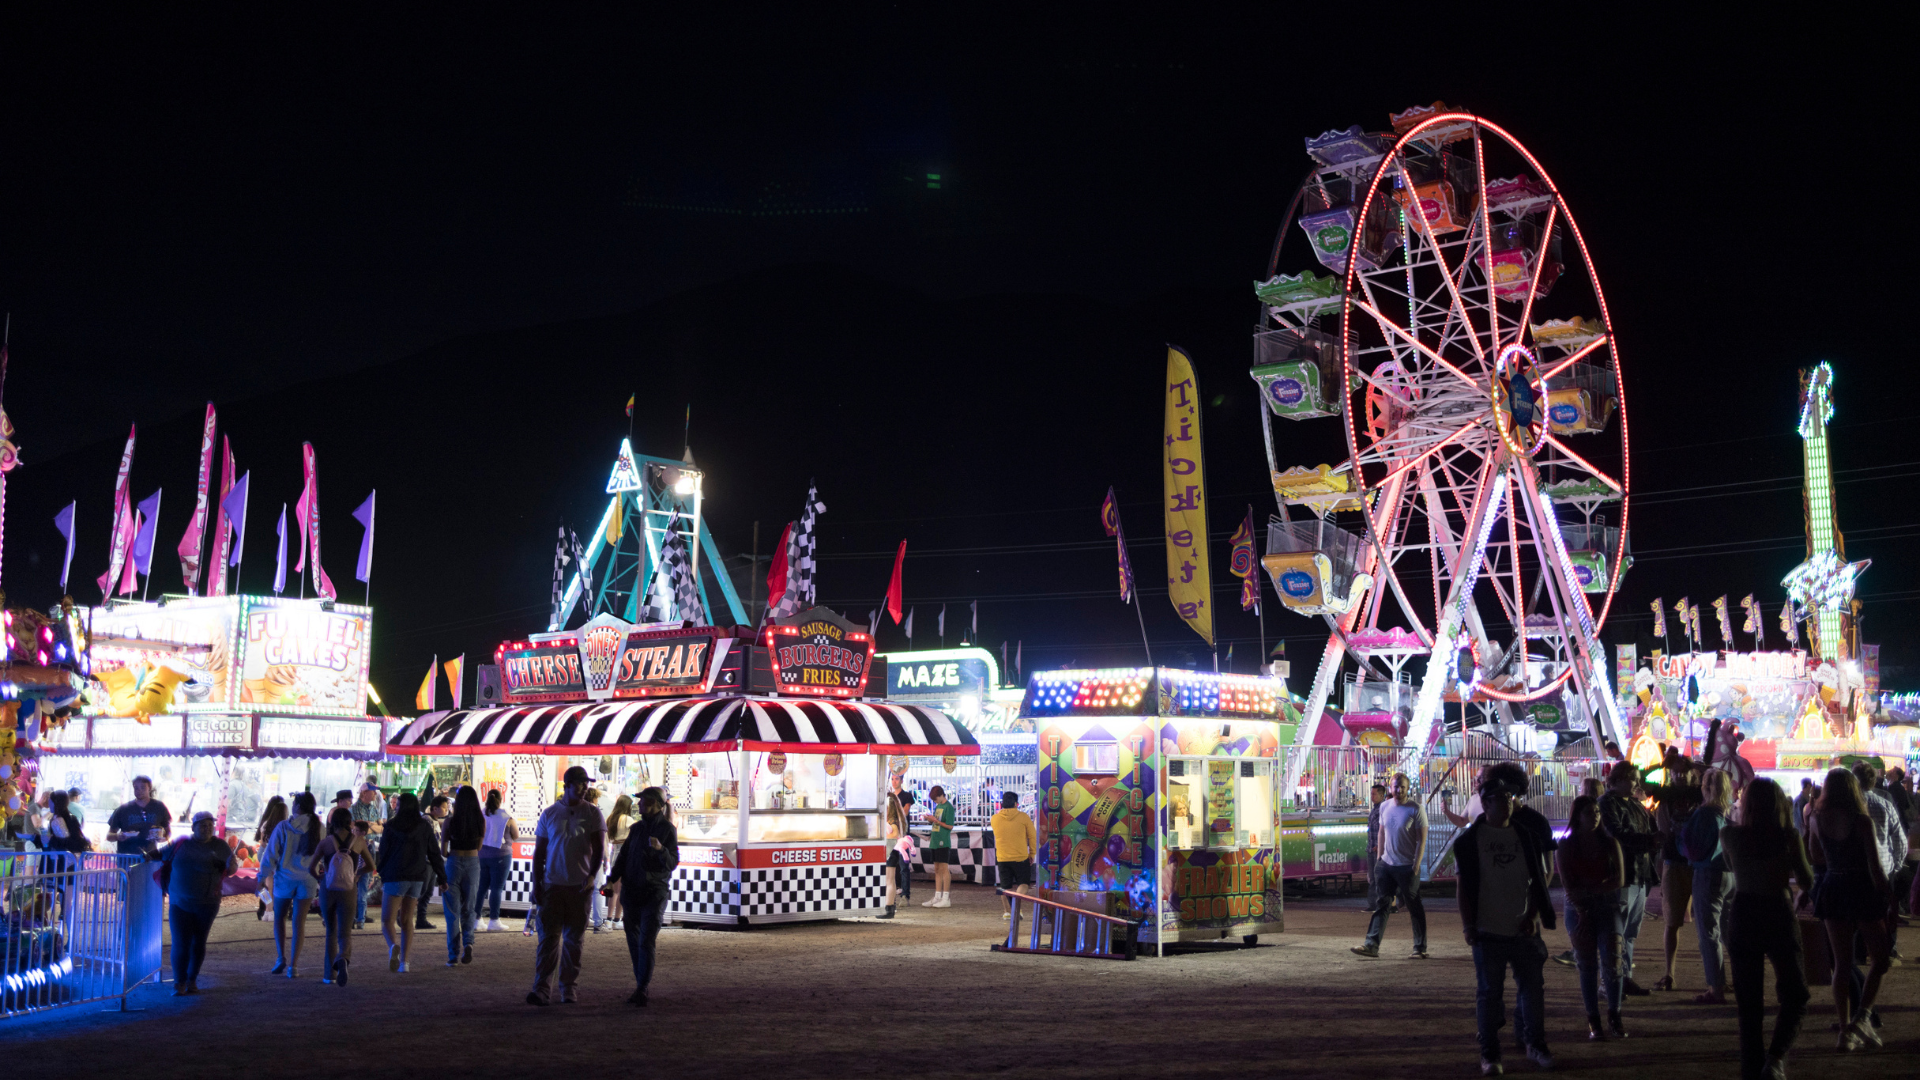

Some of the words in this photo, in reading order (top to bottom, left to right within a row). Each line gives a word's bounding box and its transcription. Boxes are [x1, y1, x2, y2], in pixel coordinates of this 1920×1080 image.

[249, 610, 359, 650] FUNNEL
[801, 621, 843, 642] SAUSAGE
[265, 638, 348, 672] CAKES
[587, 633, 616, 658] DINER
[505, 653, 582, 689] CHEESE
[618, 643, 708, 683] STEAK
[779, 643, 864, 675] BURGERS
[1726, 650, 1807, 680] FACTORY
[187, 669, 215, 686] OREO
[802, 668, 841, 686] FRIES
[897, 663, 960, 689] MAZE
[1178, 679, 1278, 715] TICKETS
[190, 719, 208, 731] ICE
[209, 718, 247, 732] COLD
[193, 731, 243, 743] DRINKS
[1782, 755, 1800, 767] SNO
[1096, 796, 1111, 818] ADMIT
[1102, 800, 1113, 815] ONE
[1048, 734, 1061, 913] TICKET
[771, 849, 817, 864] CHEESE
[820, 848, 862, 862] STEAKS
[1075, 848, 1084, 868] ADMIT
[1079, 853, 1087, 866] ONE
[1314, 842, 1348, 871] Frazier
[1179, 864, 1265, 897] FRAZIER
[1179, 894, 1264, 921] SHOWS
